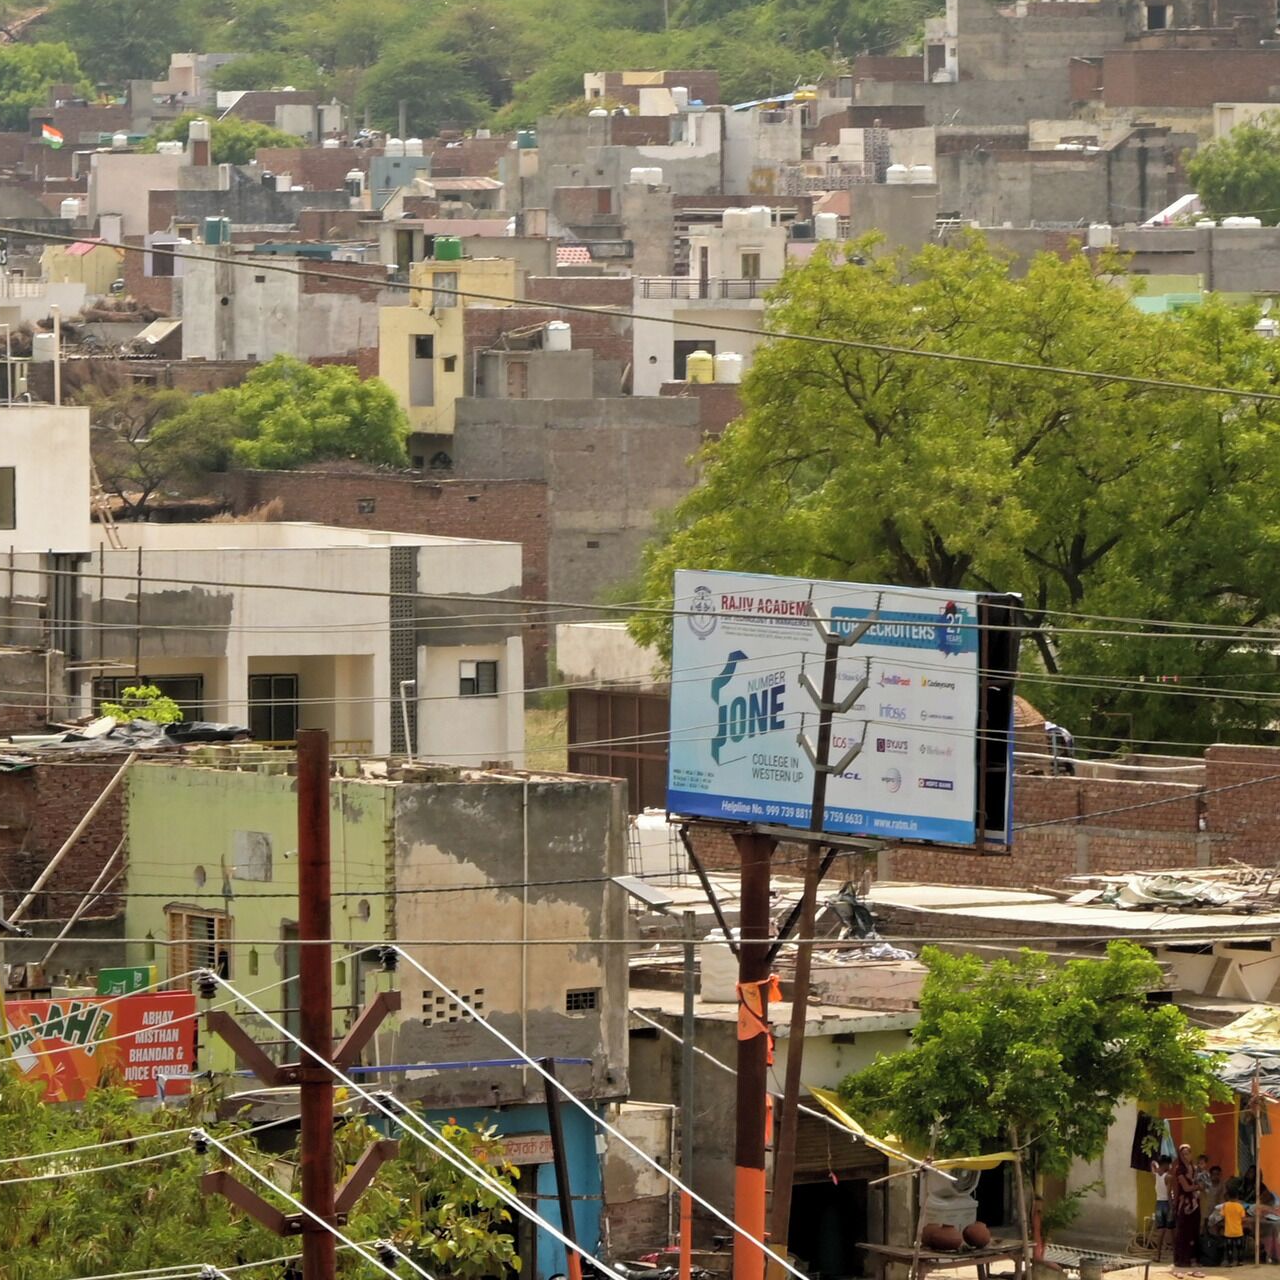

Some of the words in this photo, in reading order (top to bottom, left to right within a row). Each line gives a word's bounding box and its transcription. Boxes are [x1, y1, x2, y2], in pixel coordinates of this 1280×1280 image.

[721, 595, 754, 612] RAJIV
[864, 620, 935, 639] ECRUITERS
[946, 613, 963, 634] 27
[748, 671, 786, 692] NUMBER
[880, 703, 907, 721] Infosys
[753, 754, 788, 768] COLLEGE
[790, 758, 799, 768] IN
[752, 768, 791, 782] WESTERN
[792, 772, 804, 783] UP
[721, 800, 751, 814] Helpline
[752, 803, 765, 815] No.
[766, 805, 780, 816] 999
[781, 806, 794, 817] 739
[830, 811, 843, 823] 759
[845, 813, 863, 825] 6633
[874, 818, 918, 832] www.ratm.in
[142, 1010, 174, 1026] ABHAY
[135, 1028, 180, 1044] MISTHAN
[129, 1046, 174, 1063] BHANDAR
[176, 1046, 184, 1060] &
[122, 1065, 150, 1081] JUICE
[151, 1063, 189, 1079] CORNER
